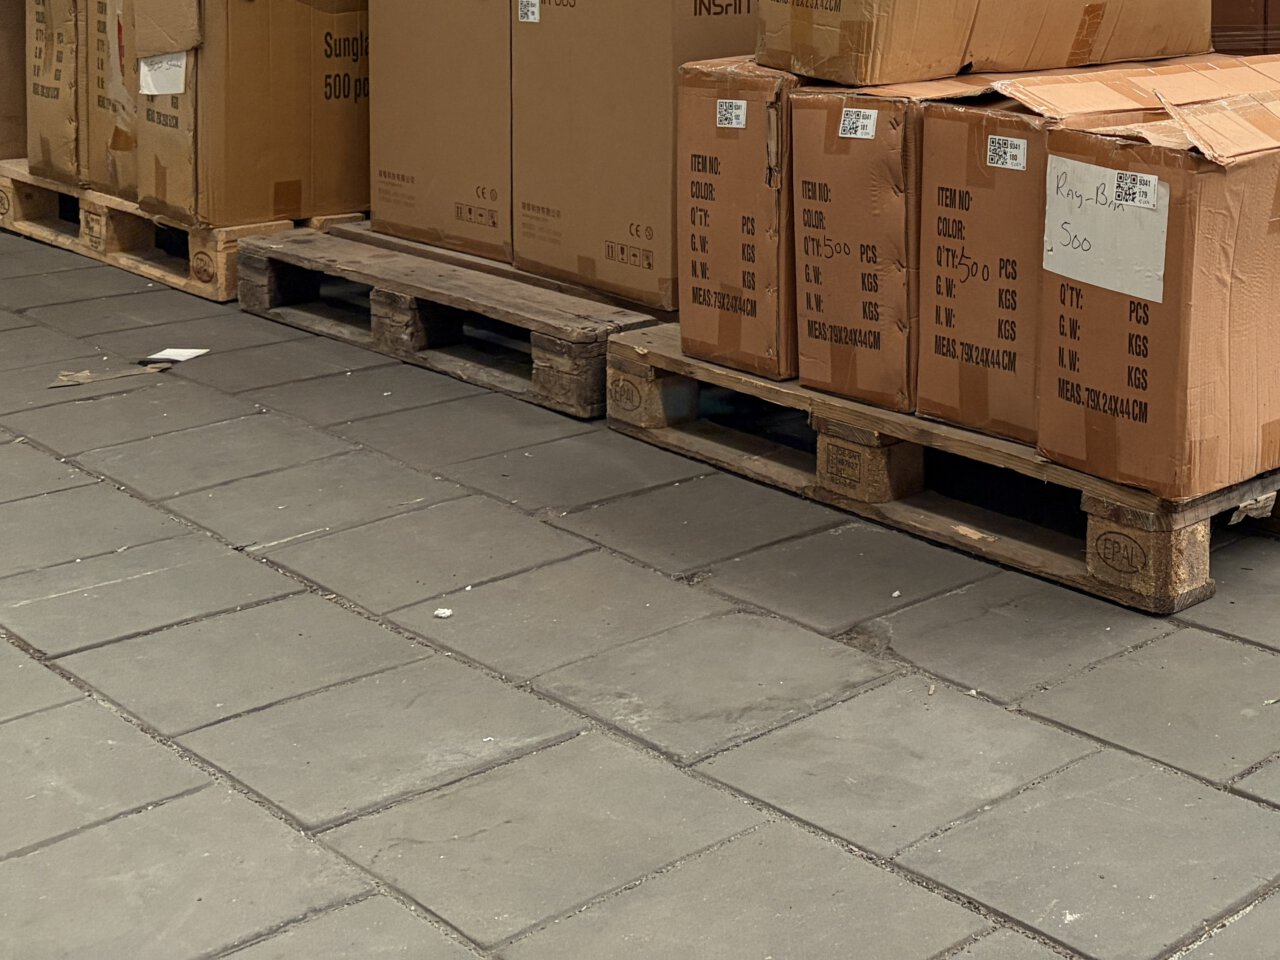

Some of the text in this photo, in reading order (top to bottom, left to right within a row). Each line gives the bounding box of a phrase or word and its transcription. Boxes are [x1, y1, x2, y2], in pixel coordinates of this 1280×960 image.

[324, 32, 370, 61] Sungla
[324, 74, 370, 104] 500 pc
[1009, 142, 1021, 151] 9341
[691, 154, 721, 176] ITEM NO:
[691, 181, 716, 202] COLOR:
[802, 180, 832, 203] ITEM NO:
[1138, 178, 1151, 187] 9341
[937, 186, 957, 209] ITEM
[1138, 191, 1148, 199] 179
[690, 206, 756, 236] Q'TY: PCS
[802, 208, 826, 230] COLOR:
[937, 216, 966, 241] COLOR:
[742, 243, 756, 264] KGS
[804, 236, 877, 265] Q'TY: PCS
[823, 235, 851, 259] 500
[936, 245, 1018, 281] Q'TY: PCS
[958, 246, 990, 284] 500
[742, 270, 756, 291] KGS
[861, 273, 879, 294] KGS
[862, 301, 880, 322] KGS
[998, 288, 1017, 312] KGS
[1060, 283, 1149, 327] Q'TY: PCS
[998, 318, 1017, 342] KGS
[1128, 332, 1149, 359] KGS
[1127, 365, 1148, 392] KGS
